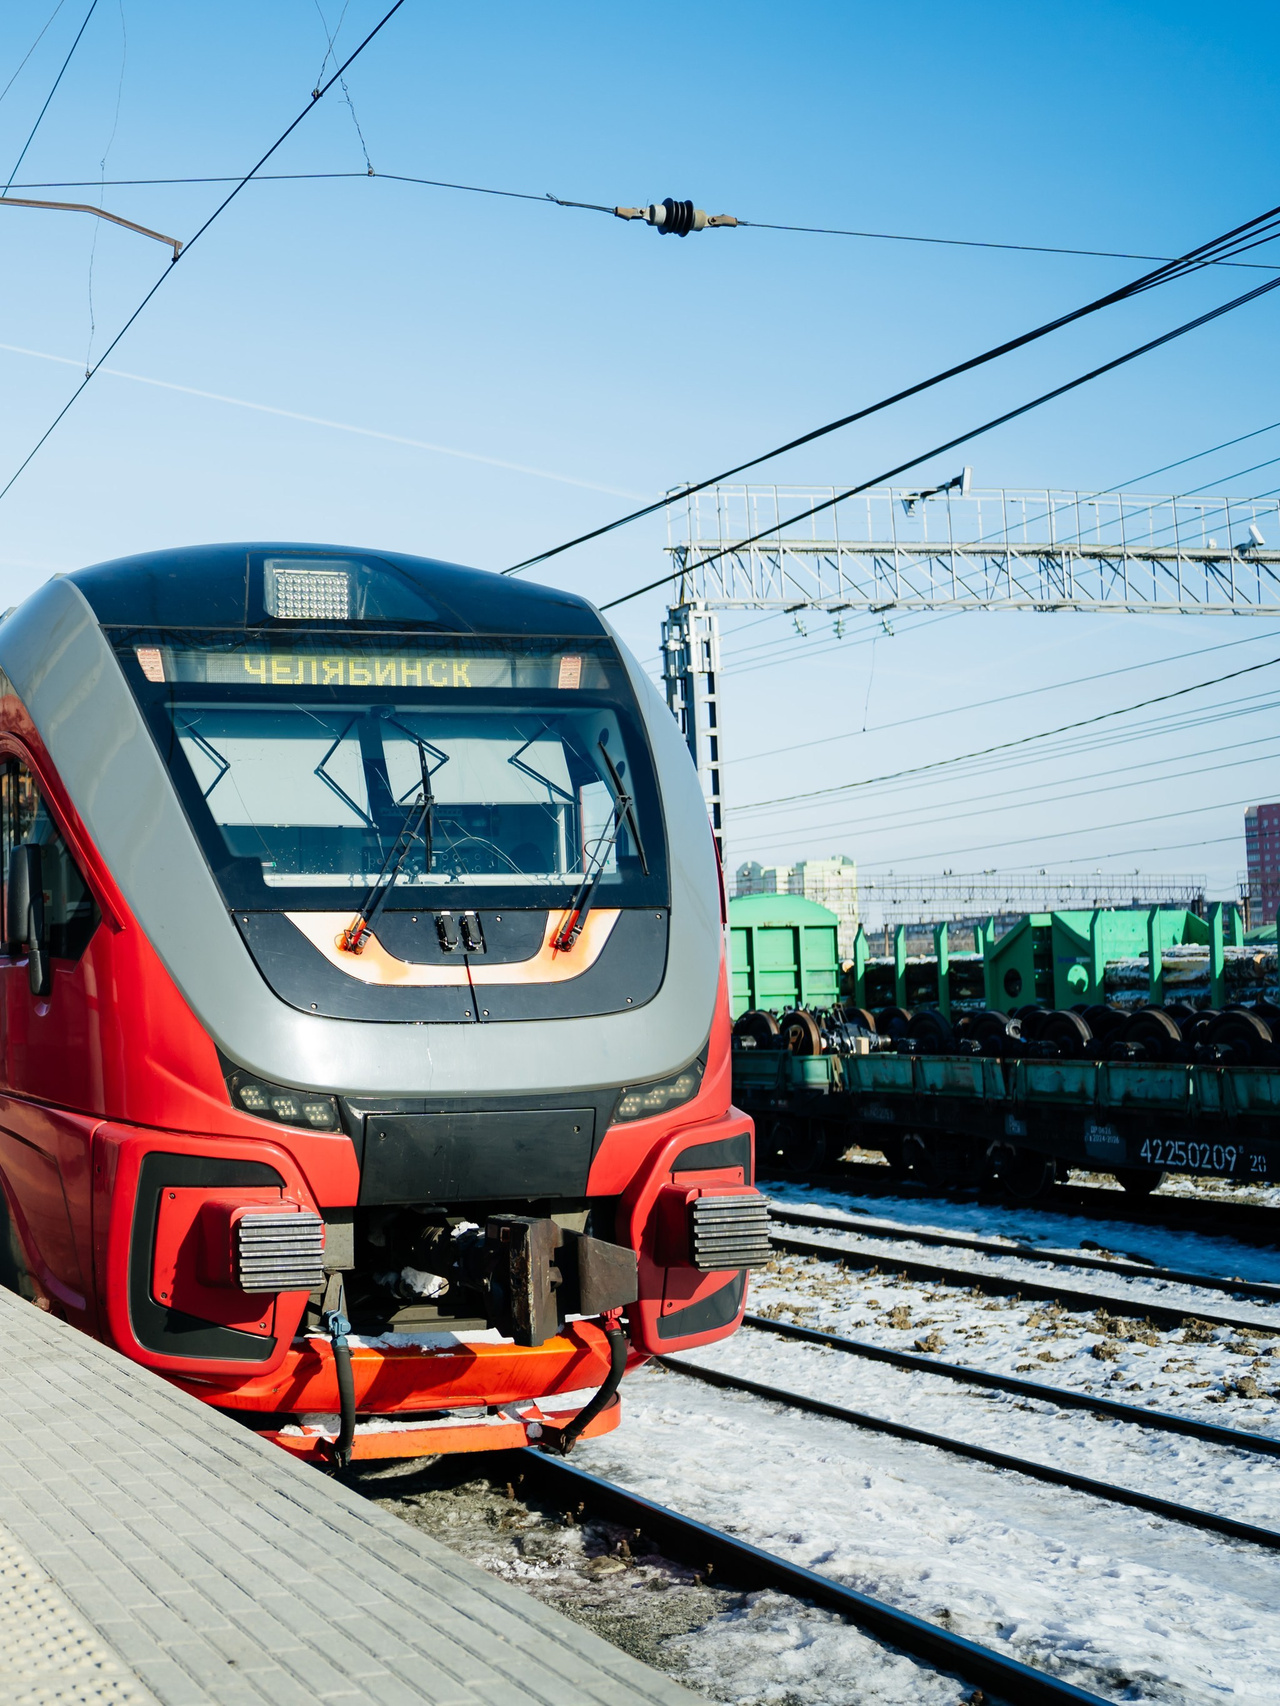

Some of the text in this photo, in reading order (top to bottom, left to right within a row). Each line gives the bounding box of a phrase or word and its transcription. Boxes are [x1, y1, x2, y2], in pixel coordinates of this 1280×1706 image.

[244, 655, 471, 688] ЧЕЛЯБИНСК
[1140, 1138, 1237, 1172] 42250209
[1249, 1154, 1267, 1172] 20
